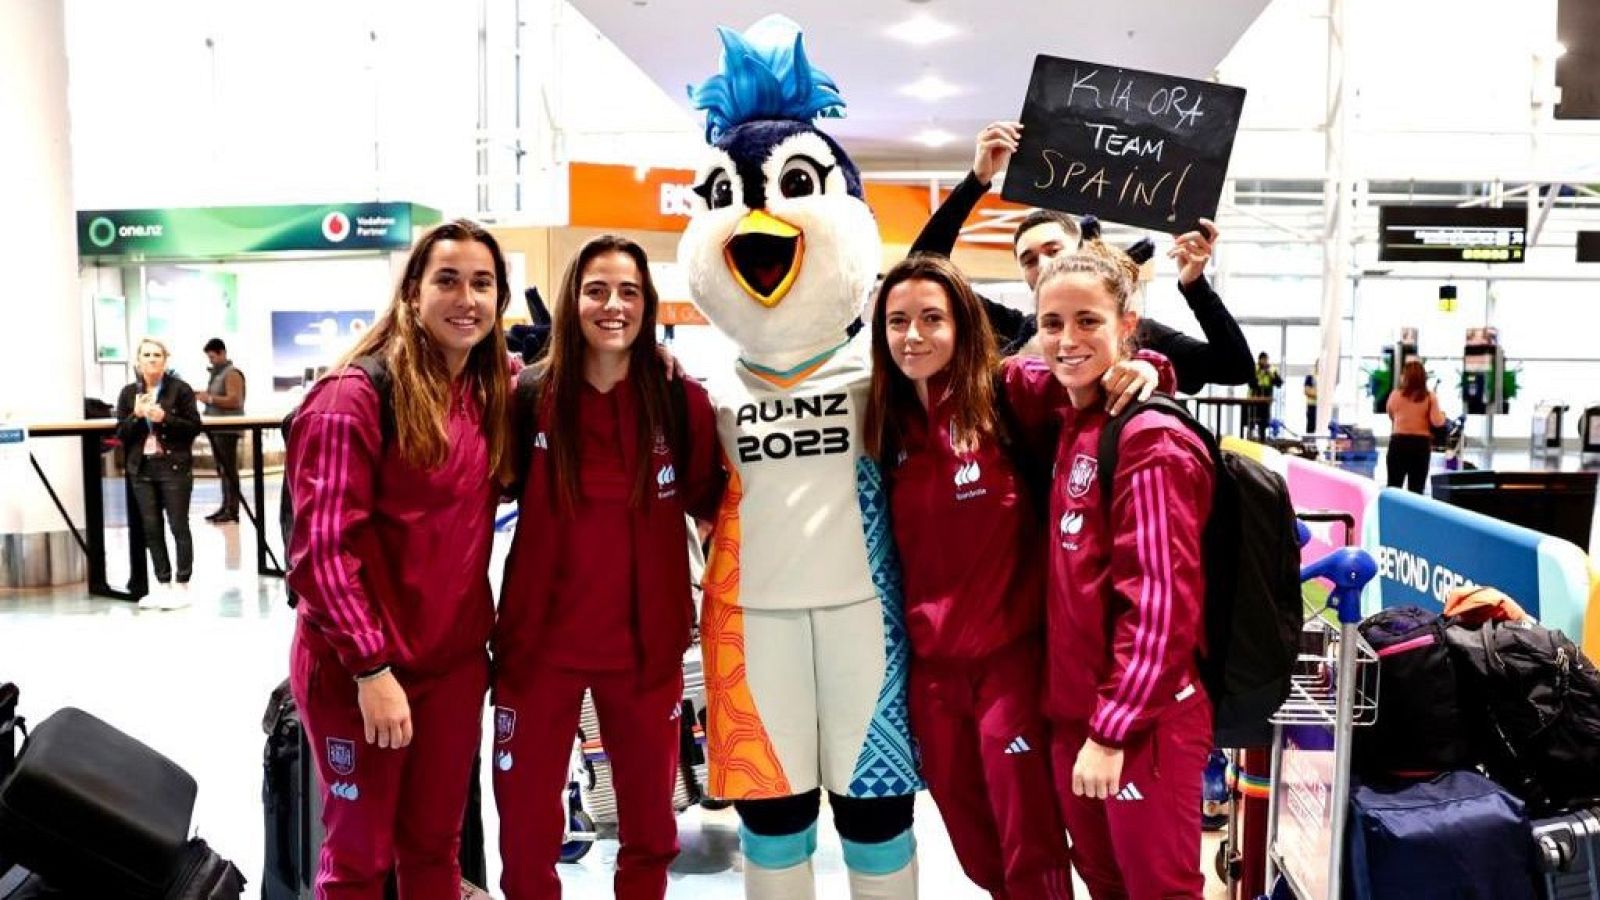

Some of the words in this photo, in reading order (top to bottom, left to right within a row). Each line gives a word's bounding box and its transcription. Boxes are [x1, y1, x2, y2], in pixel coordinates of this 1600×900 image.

[1147, 86, 1204, 129] ORA
[1084, 121, 1165, 162] TEAM
[118, 225, 163, 237] one.nz
[736, 427, 850, 463] 2023
[1378, 546, 1429, 593] BEYOND
